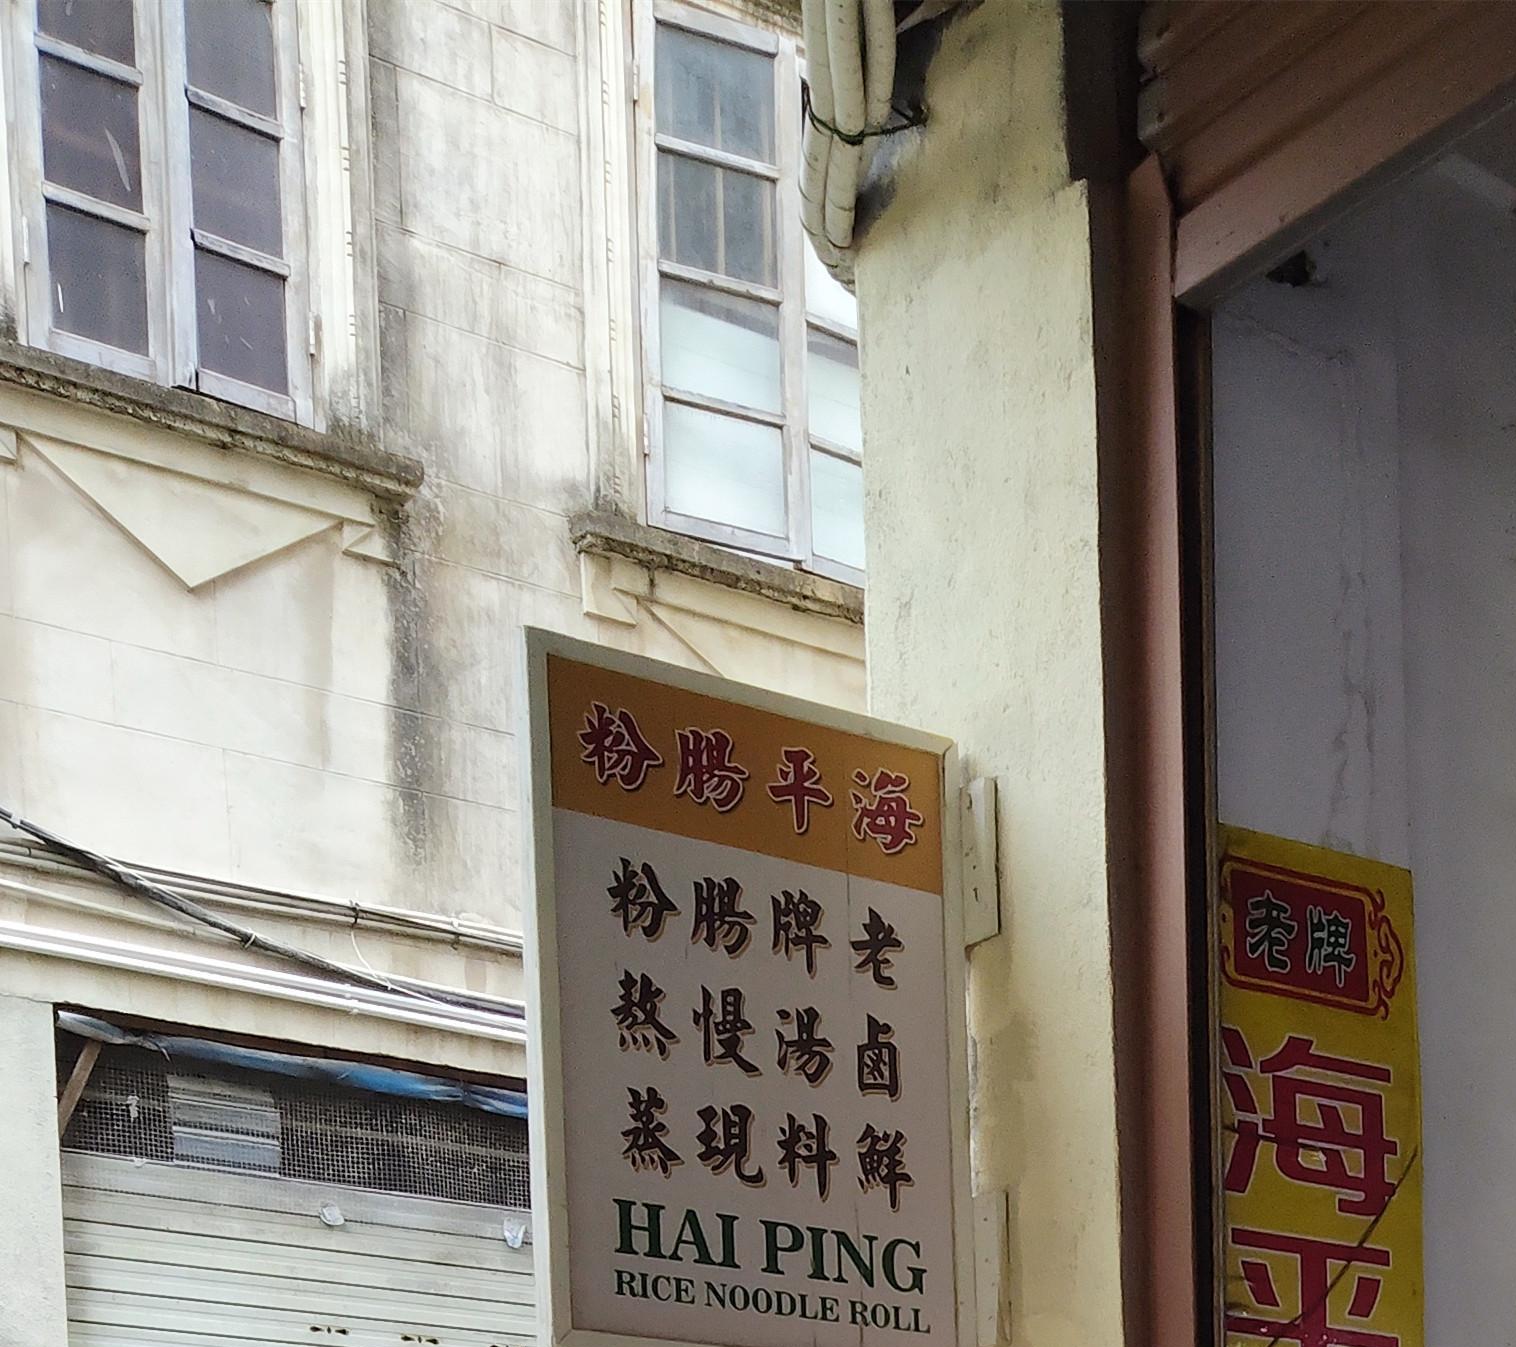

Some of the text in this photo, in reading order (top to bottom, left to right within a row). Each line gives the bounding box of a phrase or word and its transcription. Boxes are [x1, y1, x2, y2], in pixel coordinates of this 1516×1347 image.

[1246, 890, 1357, 988] 老牌
[612, 1198, 928, 1295] HAI PING
[614, 1269, 931, 1334] RICE NOODLE ROLL
